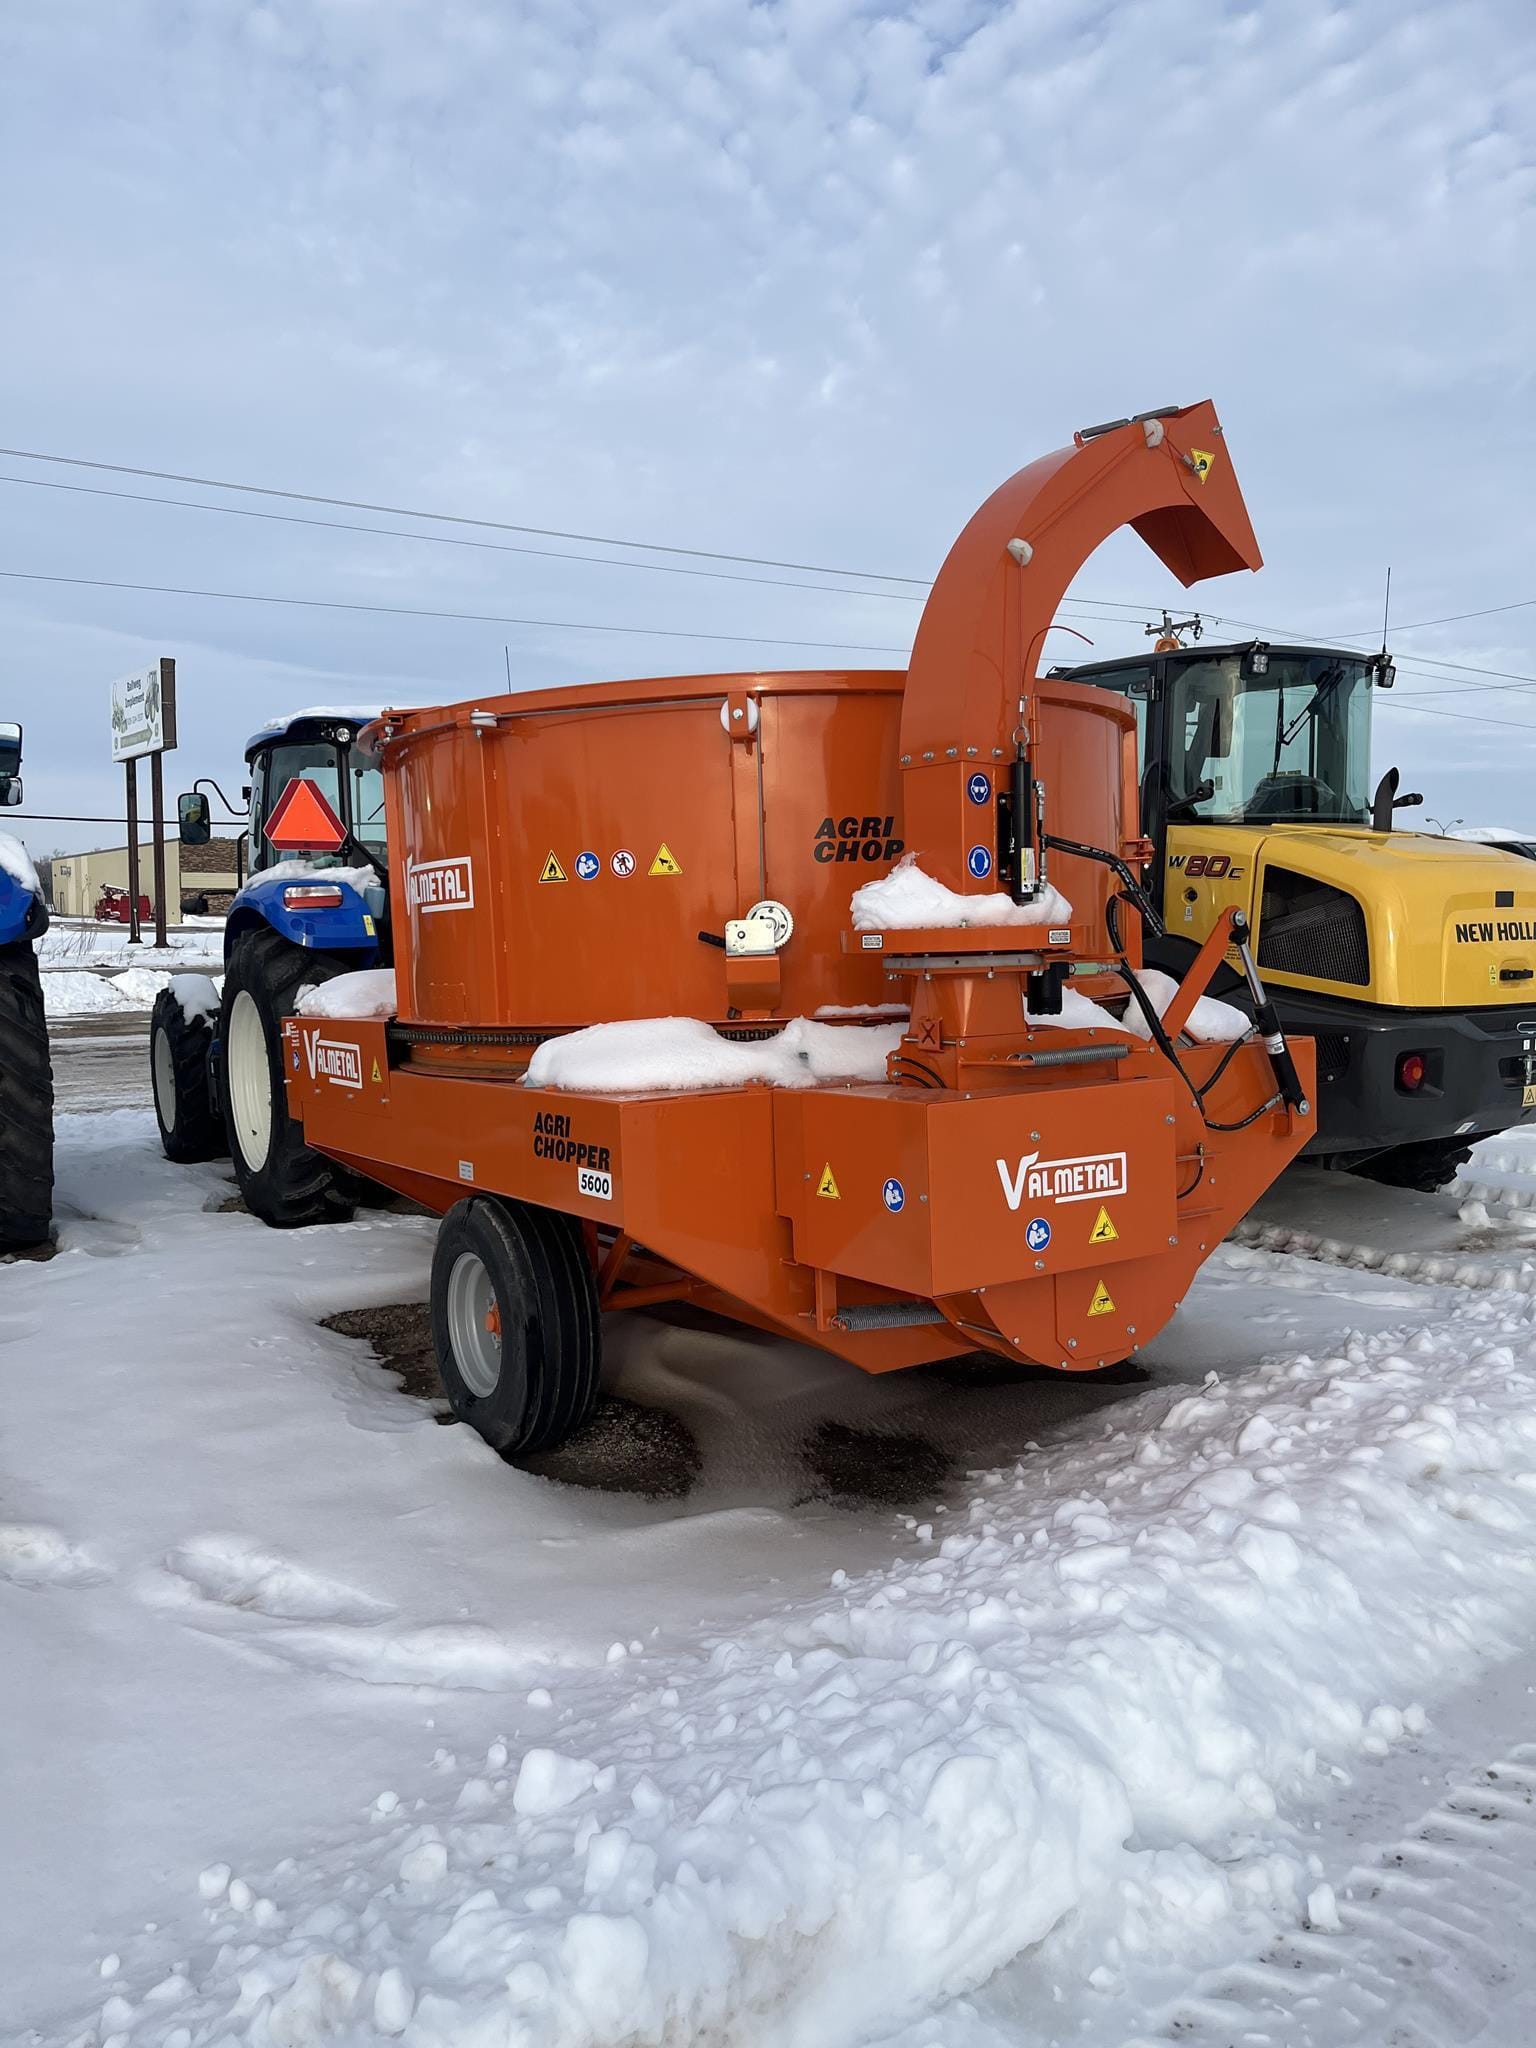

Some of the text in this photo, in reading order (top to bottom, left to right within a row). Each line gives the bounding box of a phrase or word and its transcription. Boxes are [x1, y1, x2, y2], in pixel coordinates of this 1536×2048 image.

[814, 816, 894, 839] AGRI
[402, 853, 466, 916] VALMETAL
[1455, 922, 1536, 943] NEW HOLL
[303, 1028, 359, 1080] VALMETAL
[533, 1111, 571, 1138] AGRI
[533, 1135, 610, 1172] CHOPPER
[581, 1173, 610, 1195] 5600
[996, 1151, 1119, 1211] VALMETAL
